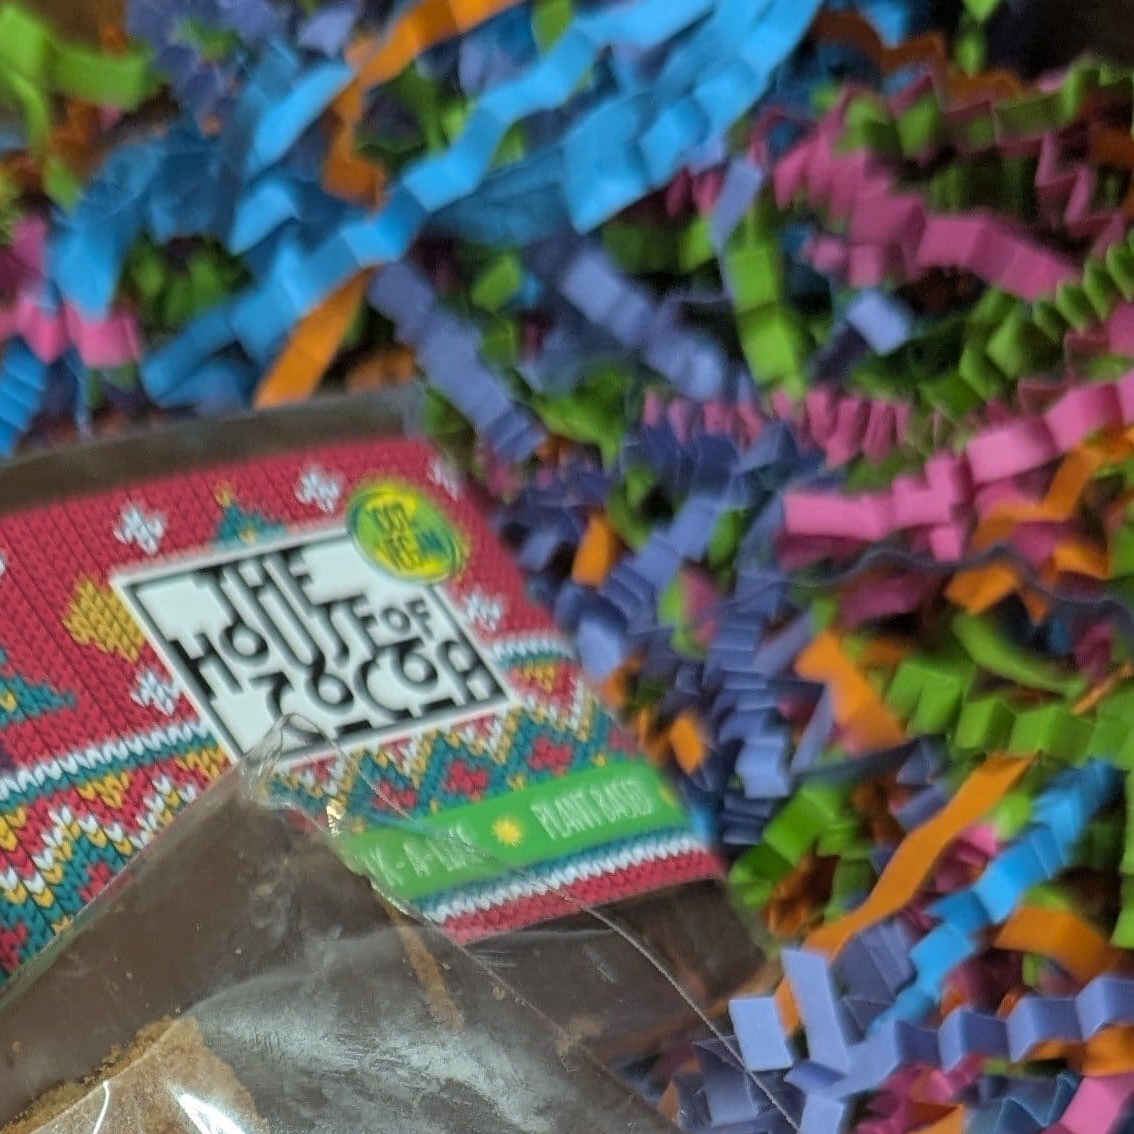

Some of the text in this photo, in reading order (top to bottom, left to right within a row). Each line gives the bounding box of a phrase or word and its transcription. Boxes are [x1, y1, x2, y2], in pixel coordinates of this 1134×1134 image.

[197, 545, 313, 627] THE
[170, 594, 435, 698] HOUSE OF
[250, 637, 508, 742] COCOA
[530, 789, 604, 841] PLANT
